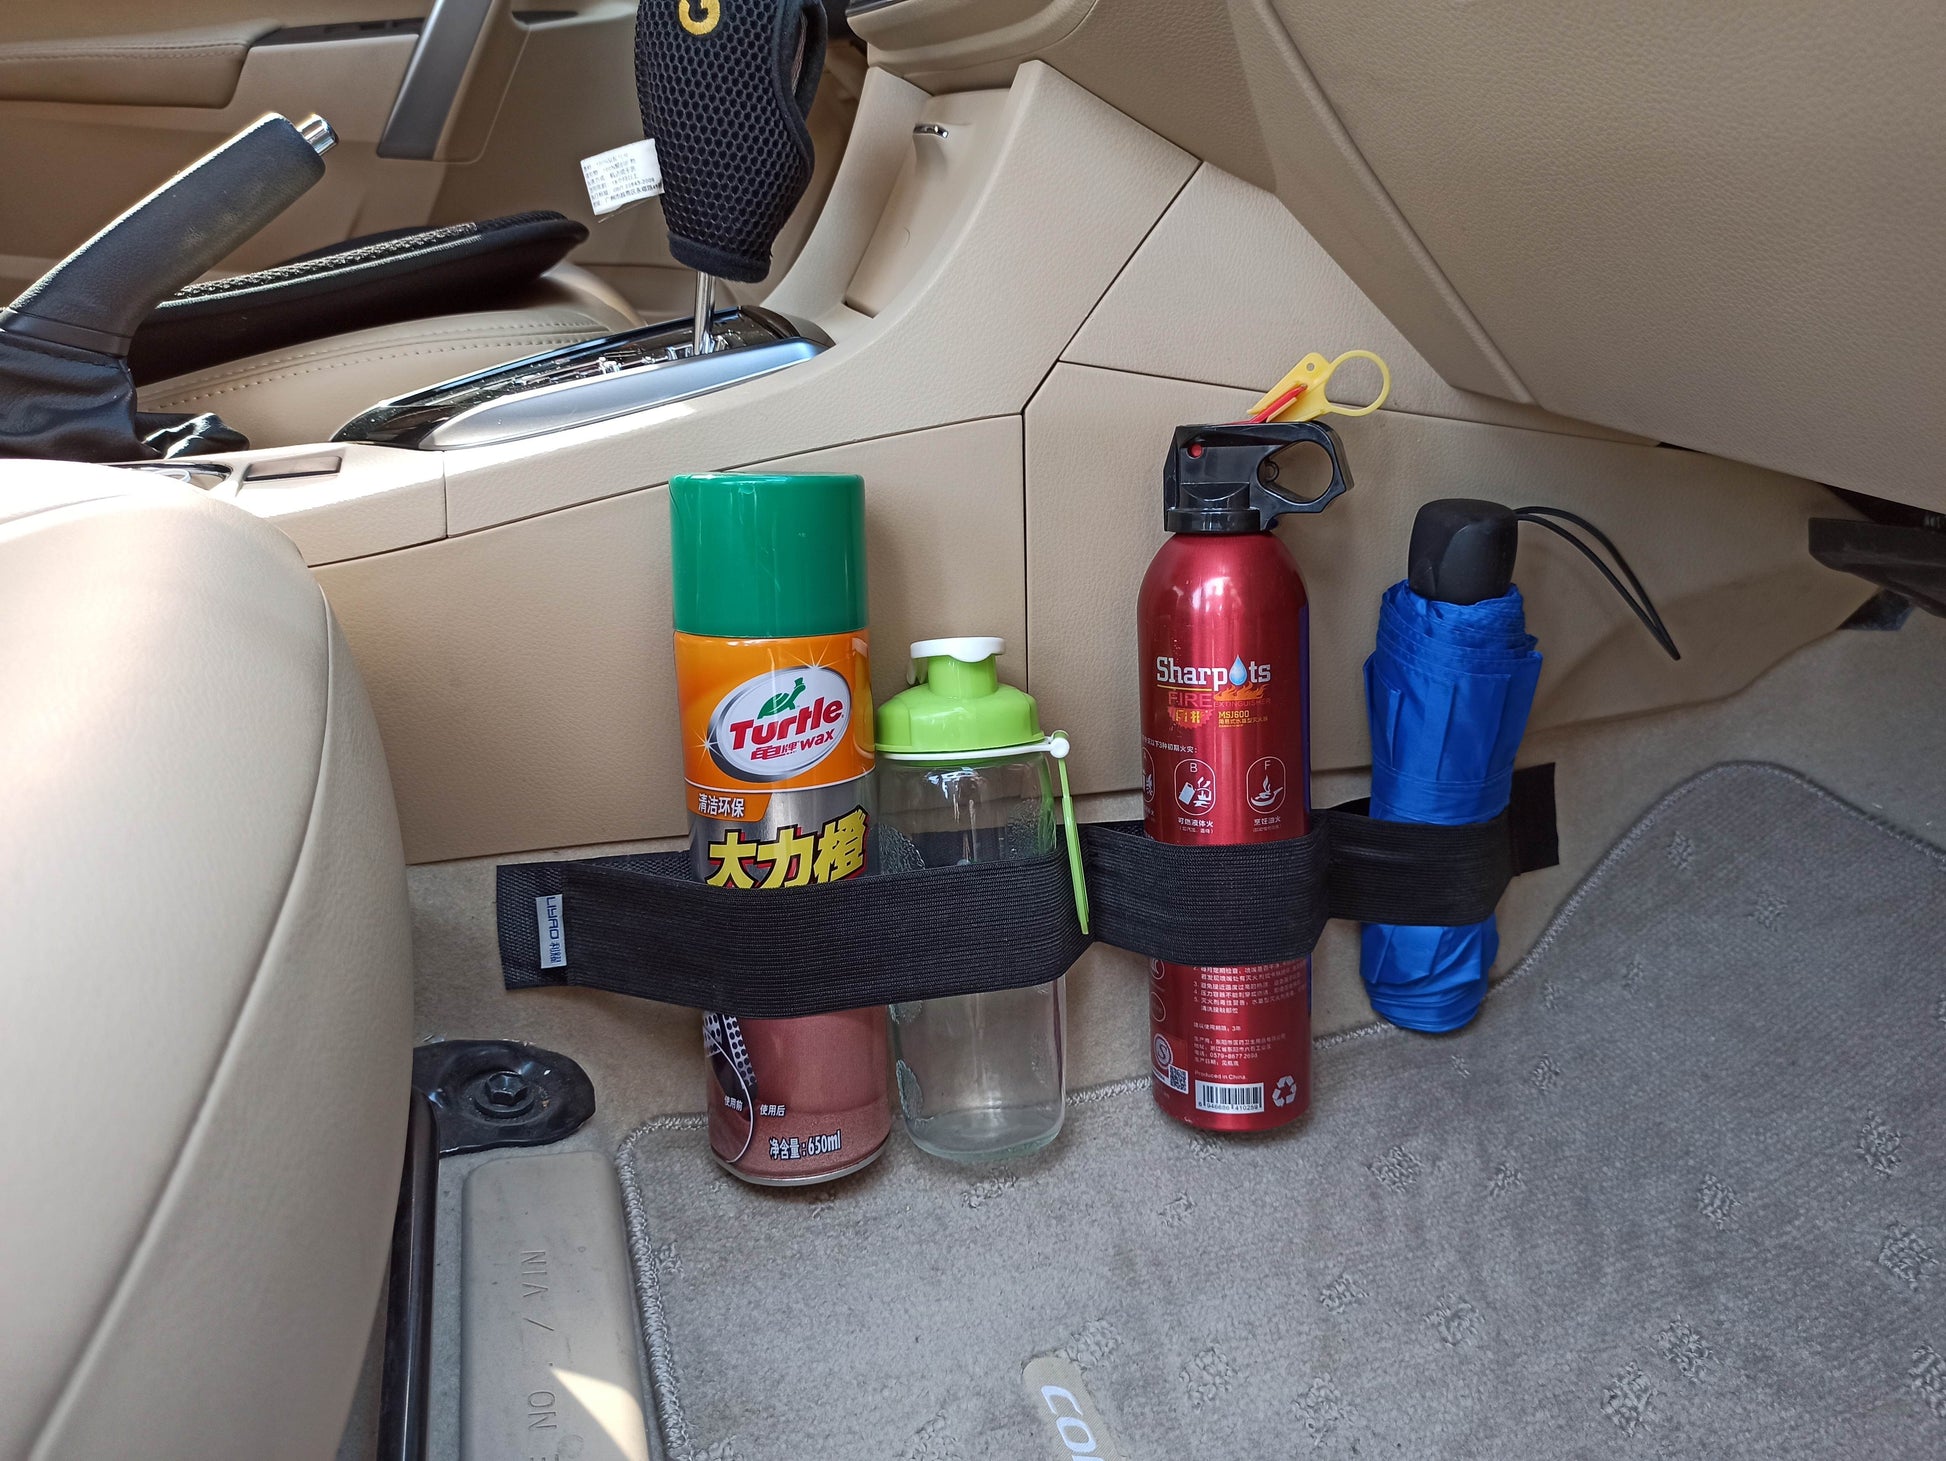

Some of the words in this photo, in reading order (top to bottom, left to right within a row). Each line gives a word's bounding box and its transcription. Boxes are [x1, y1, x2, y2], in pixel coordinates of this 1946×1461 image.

[1168, 691, 1213, 708] FIRE
[729, 696, 844, 750] Turtle
[1218, 710, 1250, 719] MSJ600
[800, 728, 835, 751] wax
[1189, 762, 1199, 774] B
[1264, 760, 1271, 770] F
[697, 793, 745, 818] 清洁环保
[705, 806, 868, 889] 大力橙
[724, 1096, 743, 1112] 使用前
[760, 1104, 786, 1117] 使用后
[769, 1130, 842, 1160] 净含量：650ml
[520, 1249, 549, 1298] VIN
[1040, 1384, 1105, 1461] CO
